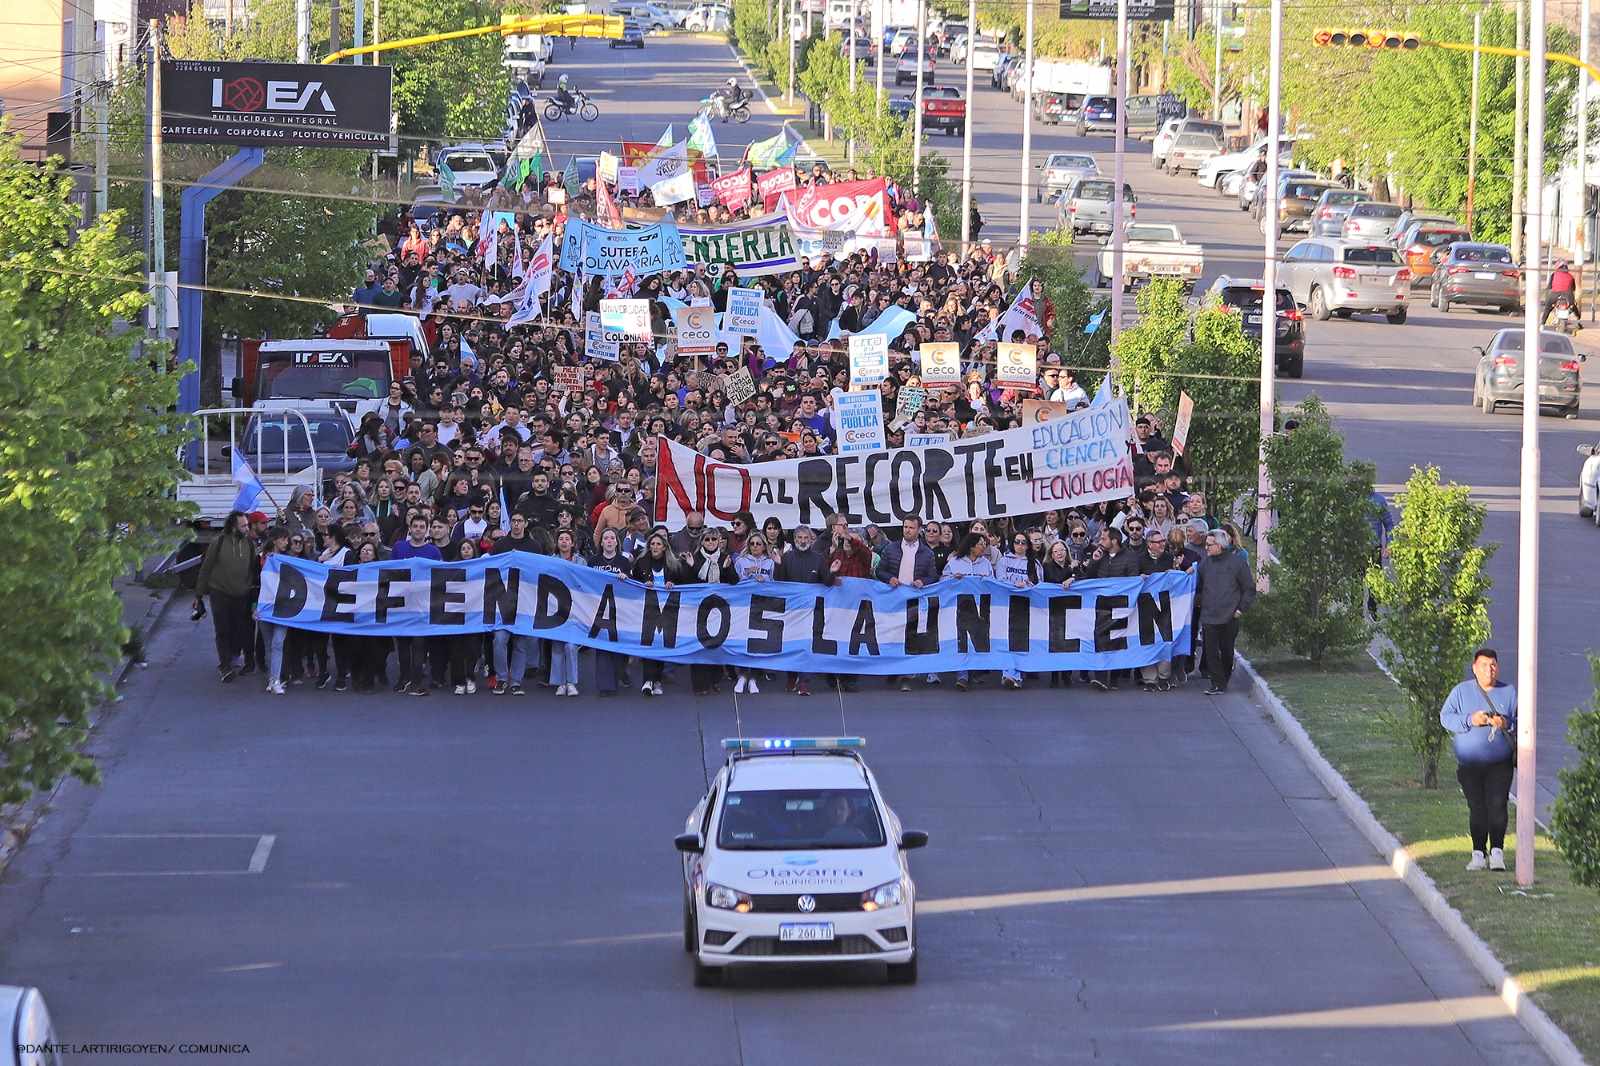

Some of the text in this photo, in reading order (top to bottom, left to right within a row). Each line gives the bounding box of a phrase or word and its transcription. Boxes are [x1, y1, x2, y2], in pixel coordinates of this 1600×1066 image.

[212, 114, 337, 125] PUBLICIDAD INTEGRAL
[292, 131, 329, 139] PLOTEO
[332, 132, 385, 141] VEHICULAR
[681, 330, 710, 339] ceco
[926, 366, 955, 375] ceco
[1002, 365, 1031, 375] ceco
[1045, 439, 1117, 470] CIENCIA
[655, 434, 1034, 525] NO AL RECORTE EN
[1026, 458, 1133, 504] TECNOLOGÍA
[272, 563, 1174, 656] DEFENDAMOS LA UNICEN
[782, 928, 795, 939] AF
[799, 928, 816, 939] 260
